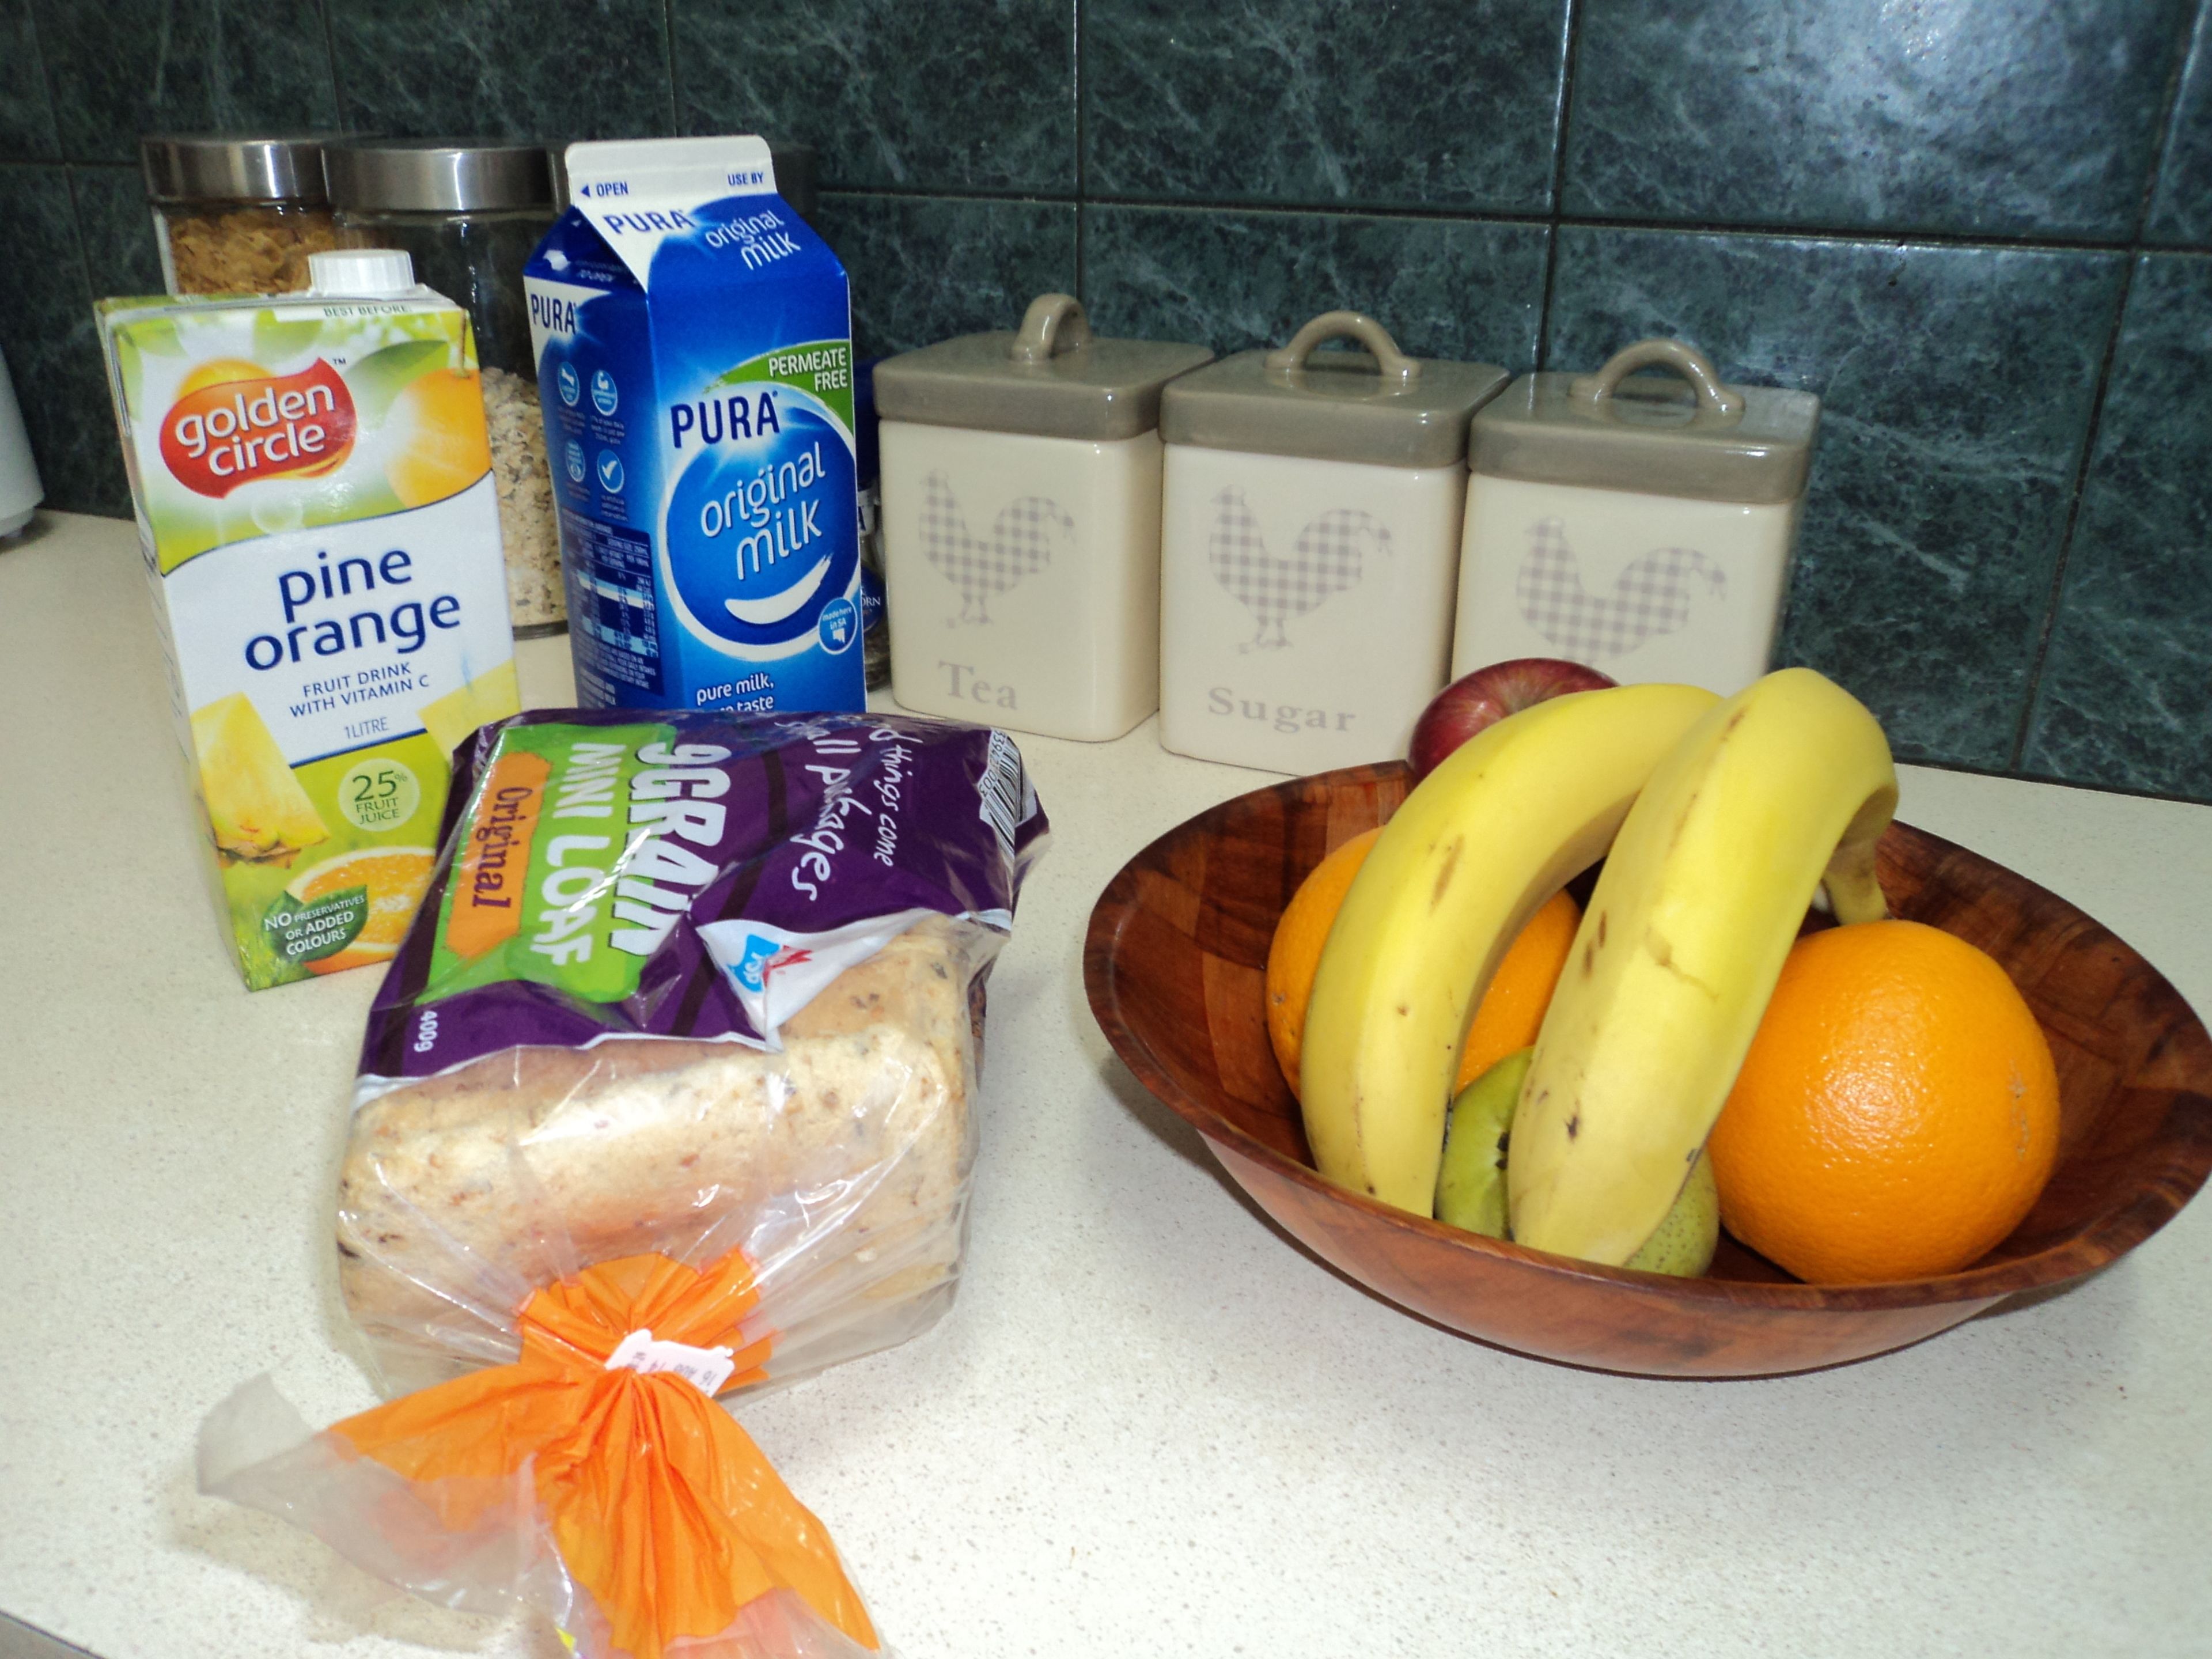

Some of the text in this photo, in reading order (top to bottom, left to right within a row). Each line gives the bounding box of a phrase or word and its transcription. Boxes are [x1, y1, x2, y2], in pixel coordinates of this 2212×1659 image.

[596, 181, 628, 196] OPEN
[728, 172, 764, 187] USE BY
[603, 210, 691, 236] PURA
[705, 210, 785, 249] original
[741, 232, 801, 271] milk
[323, 306, 353, 317] BEST
[531, 293, 577, 335] PURA
[768, 347, 847, 377] PERMEATE
[814, 369, 848, 393] FREE
[175, 384, 335, 459] golden
[671, 392, 780, 449] PURA
[209, 423, 326, 477] circle
[700, 441, 825, 538] original
[736, 499, 822, 581] milk
[278, 549, 412, 624] pine
[245, 594, 461, 672] orange
[290, 675, 430, 718] WITH VITAMIN C
[303, 662, 412, 698] FRUIT DRINK
[696, 683, 732, 706] pure
[937, 660, 1018, 710] Tea
[737, 695, 774, 712] taste
[1208, 687, 1357, 734] Sugar
[551, 742, 627, 819] MINI
[874, 744, 913, 812] things
[356, 797, 399, 813] FRUIT
[359, 808, 400, 825] JUICE
[472, 786, 534, 910] Original
[874, 813, 898, 867] come
[264, 895, 365, 931] NO PRESERVATIVES
[529, 834, 611, 967] LOAF
[286, 911, 355, 941] OR ADDED
[286, 928, 346, 956] COLOURS
[413, 1010, 438, 1053] 400g
